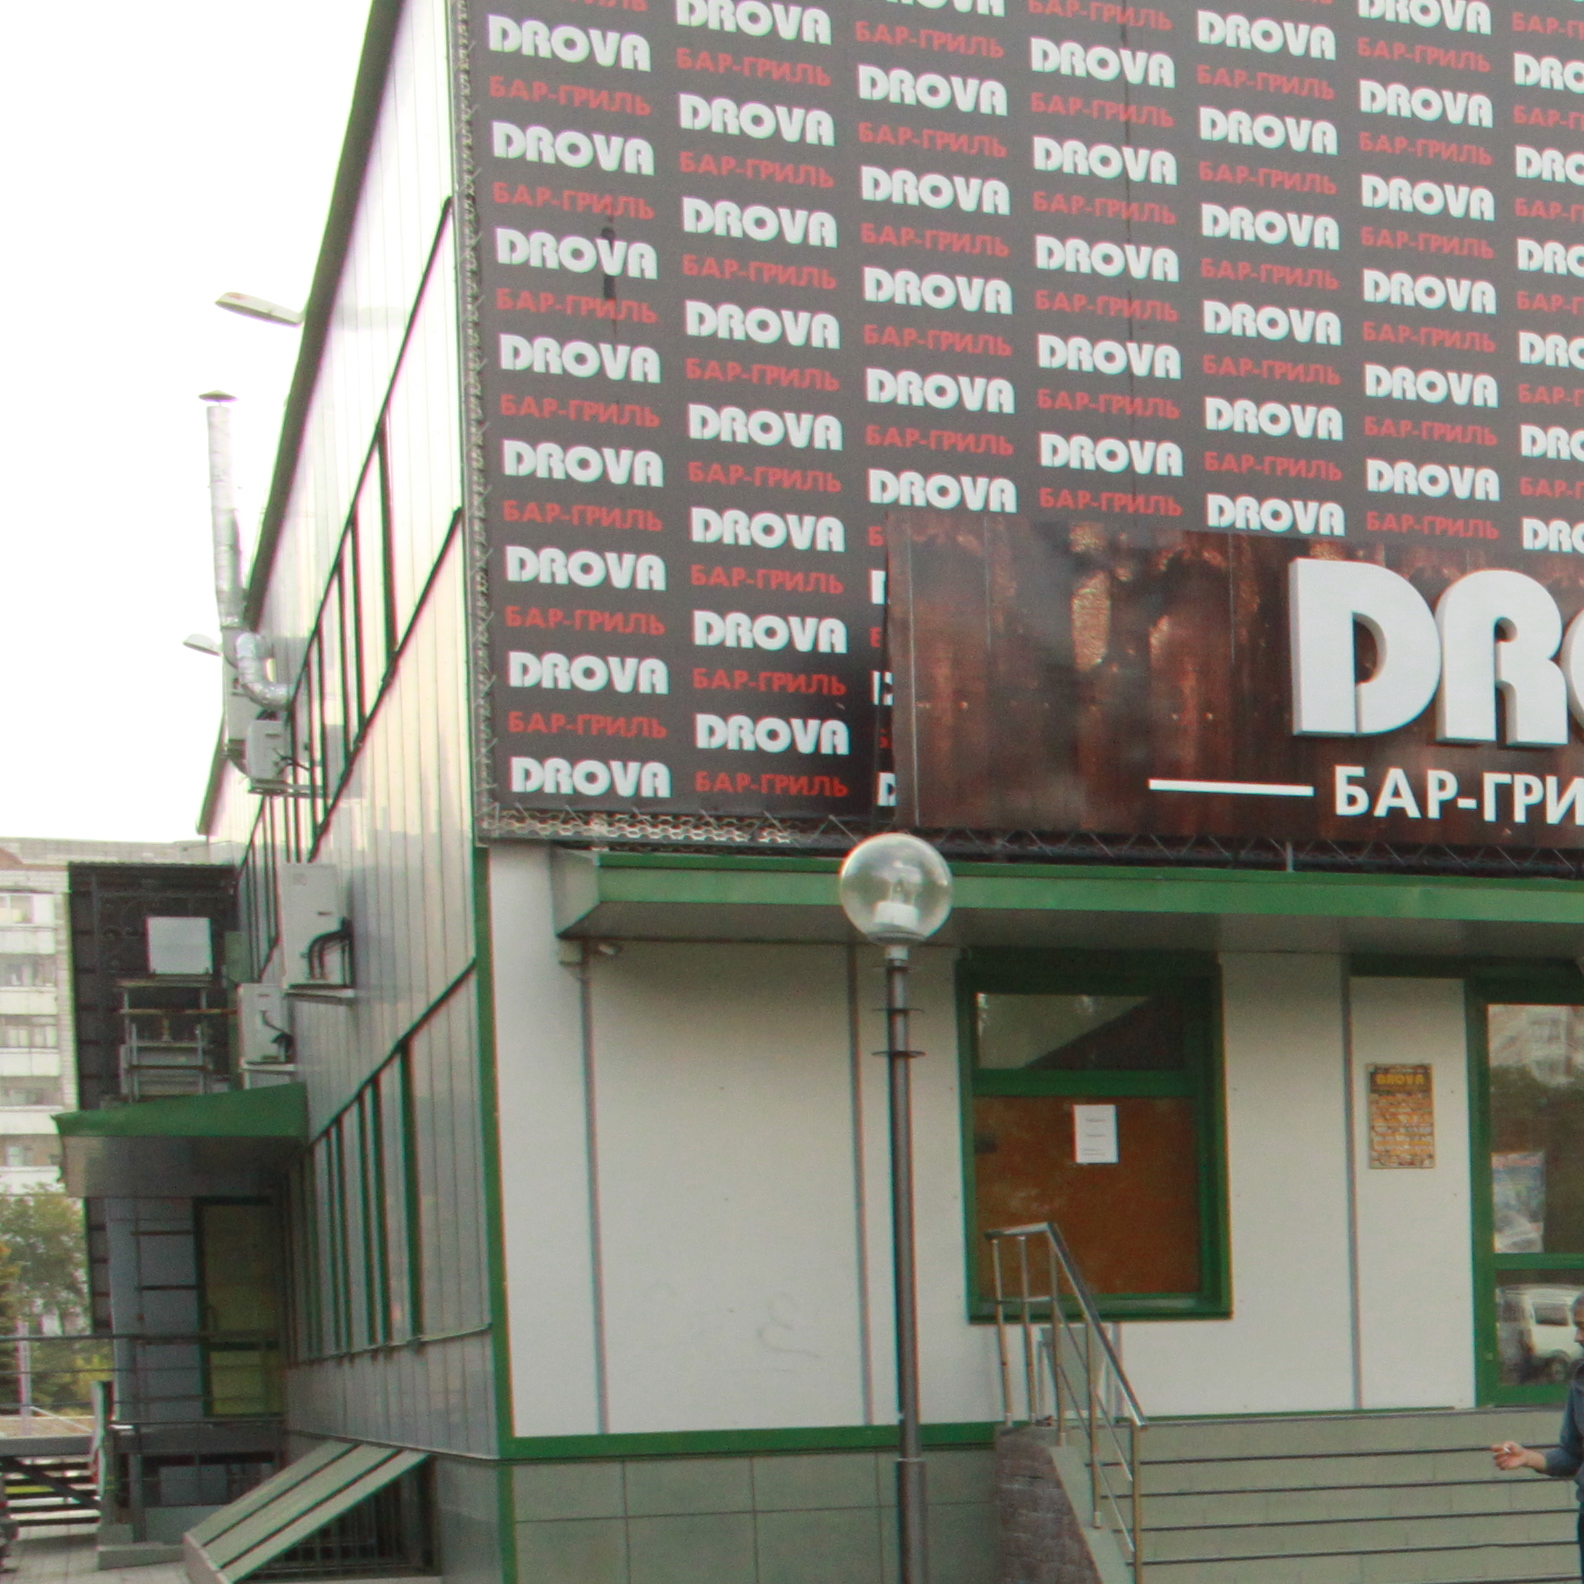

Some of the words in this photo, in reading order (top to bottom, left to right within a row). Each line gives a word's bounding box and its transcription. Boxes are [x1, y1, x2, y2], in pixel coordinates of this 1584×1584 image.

[675, 0, 831, 45] DROVA
[856, 21, 1004, 58] БАР-ГРИЛЬ
[1197, 9, 1336, 60] DROVA
[488, 14, 651, 72] DROVA
[1030, 37, 1175, 88] DROVA
[1358, 37, 1491, 72] БАР-ГРИЛЬ
[677, 48, 832, 86] БАР-ГРИЛЬ
[1198, 65, 1335, 100] БАР-ГРИЛЬ
[490, 76, 652, 116] БАР-ГРИЛЬ
[857, 64, 1007, 116] DROVA
[1031, 93, 1175, 127] БАР-ГРИЛЬ
[1359, 79, 1493, 128] DROVA
[679, 93, 834, 146] DROVA
[1199, 106, 1337, 155] DROVA
[492, 121, 654, 175] DROVA
[858, 122, 1008, 158] БАР-ГРИЛЬ
[1360, 132, 1494, 165] БАР-ГРИЛЬ
[680, 151, 835, 188] БАР-ГРИЛЬ
[1033, 136, 1177, 185] DROVA
[1200, 161, 1338, 194] БАР-ГРИЛЬ
[493, 182, 655, 220] БАР-ГРИЛЬ
[861, 165, 1010, 215] DROVA
[1033, 191, 1177, 225] БАР-ГРИЛЬ
[1361, 174, 1494, 221] DROVA
[682, 196, 837, 248] DROVA
[861, 223, 1010, 257] БАР-ГРИЛЬ
[1201, 203, 1339, 250] DROVA
[495, 227, 657, 279] DROVA
[1035, 235, 1179, 282] DROVA
[1361, 227, 1495, 259] БАР-ГРИЛЬ
[683, 254, 837, 289] БАР-ГРИЛЬ
[863, 266, 1012, 314] DROVA
[1201, 258, 1340, 290] БАР-ГРИЛЬ
[1363, 268, 1496, 314] DROVA
[497, 288, 659, 323] БАР-ГРИЛЬ
[685, 300, 840, 349] DROVA
[1035, 290, 1179, 322] БАР-ГРИЛЬ
[1203, 300, 1341, 345] DROVA
[864, 324, 1013, 357] БАР-ГРИЛЬ
[1037, 334, 1181, 379] DROVA
[1363, 321, 1496, 353] БАР-ГРИЛЬ
[499, 333, 660, 383] DROVA
[686, 358, 840, 391] БАР-ГРИЛЬ
[1203, 355, 1342, 385] БАР-ГРИЛЬ
[866, 367, 1014, 413] DROVA
[1037, 388, 1181, 419] БАР-ГРИЛЬ
[1364, 363, 1498, 408] DROVA
[500, 394, 661, 428] БАР-ГРИЛЬ
[688, 403, 842, 450] DROVA
[1205, 397, 1343, 440] DROVA
[1364, 416, 1498, 446] БАР-ГРИЛЬ
[866, 425, 1015, 456] БАР-ГРИЛЬ
[1040, 433, 1183, 476] DROVA
[503, 439, 663, 487] DROVA
[688, 461, 842, 493] БАР-ГРИЛЬ
[1204, 451, 1344, 481] БАР-ГРИЛЬ
[1366, 458, 1499, 501] DROVA
[868, 468, 1016, 513] DROVA
[1039, 487, 1183, 516] БАР-ГРИЛЬ
[503, 500, 664, 531] БАР-ГРИЛЬ
[691, 507, 844, 552] DROVA
[1207, 493, 1344, 536] DROVA
[1366, 511, 1500, 540] БАР-ГРИЛЬ
[506, 545, 665, 590] DROVA
[690, 564, 845, 594] БАР-ГРИЛЬ
[505, 606, 666, 635] БАР-ГРИЛЬ
[693, 610, 846, 653] DROVA
[509, 651, 668, 694] DROVA
[692, 668, 848, 696] БАР-ГРИЛЬ
[508, 711, 668, 738] БАР-ГРИЛЬ
[696, 714, 848, 754] DROVA
[511, 757, 670, 797] DROVA
[695, 771, 849, 797] БАР-ГРИЛЬ
